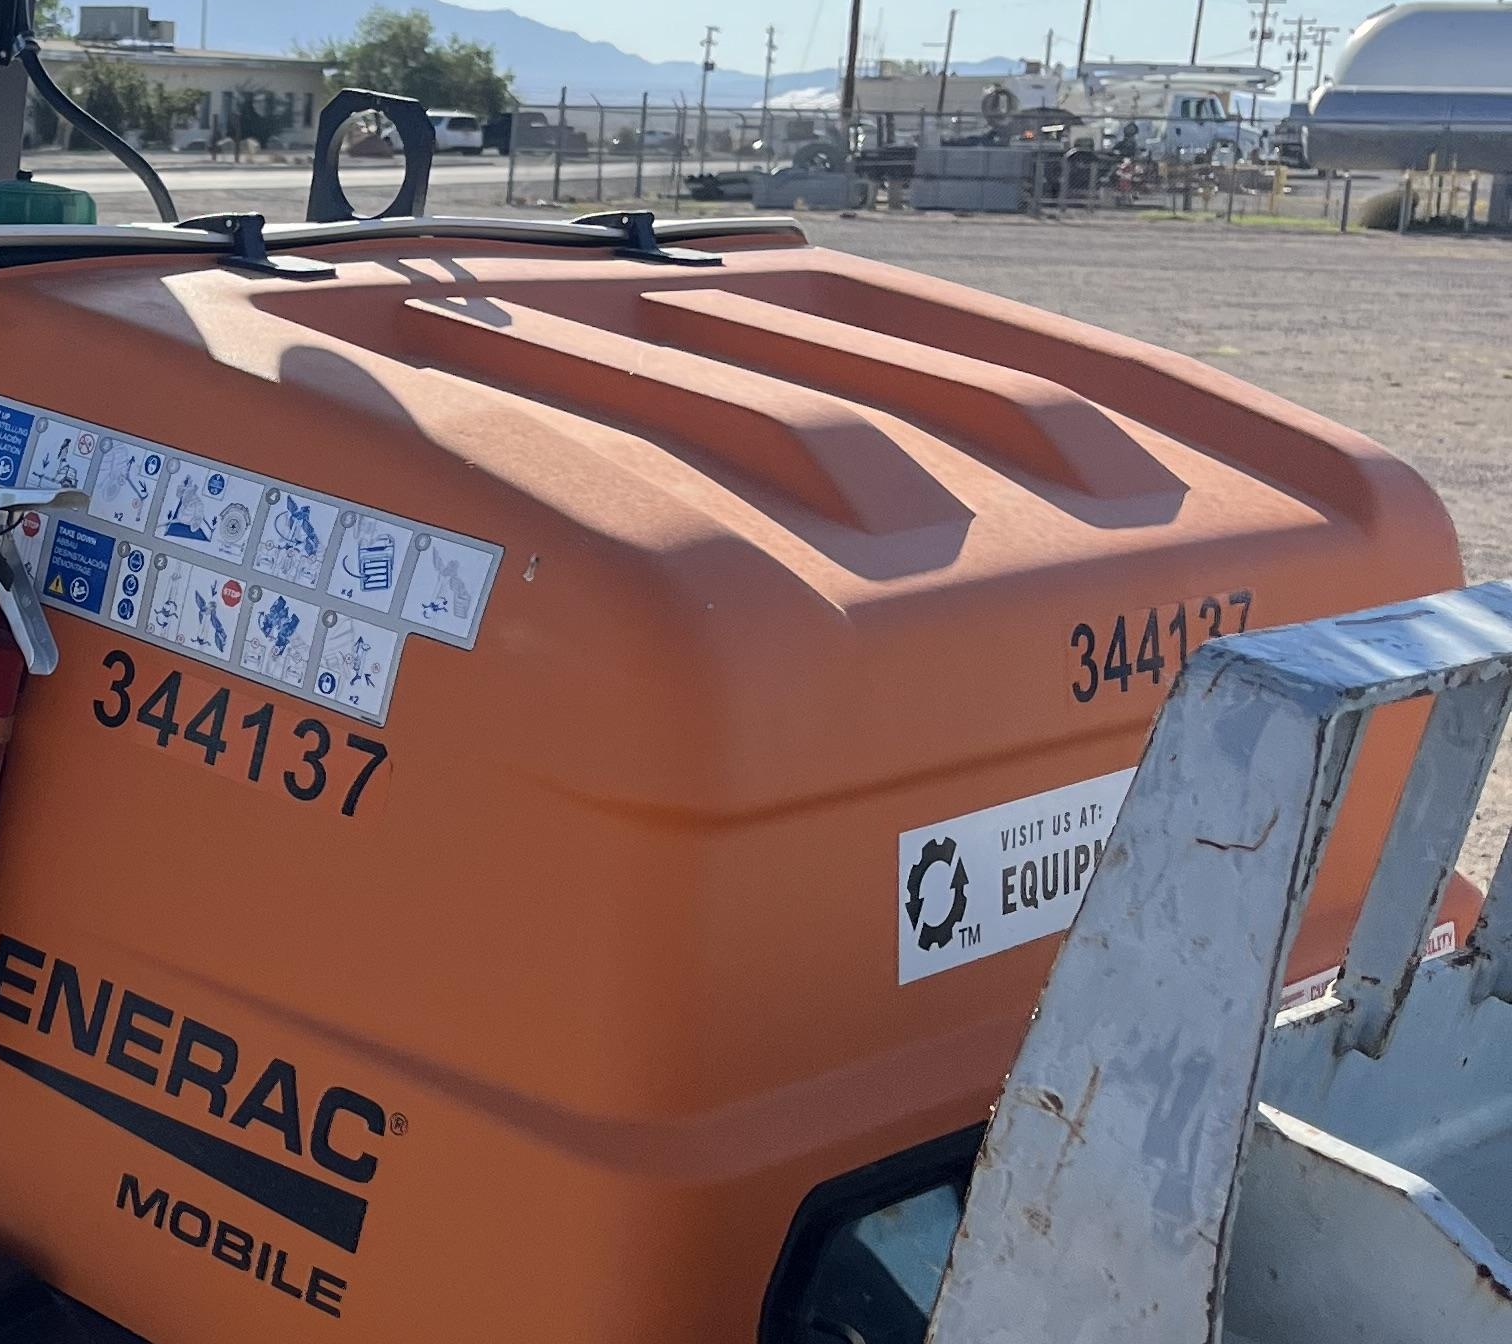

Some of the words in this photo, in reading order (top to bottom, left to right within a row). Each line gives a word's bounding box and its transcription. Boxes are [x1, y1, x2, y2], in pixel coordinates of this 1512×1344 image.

[1071, 589, 1253, 703] 344137
[93, 650, 388, 817] 344137
[1001, 819, 1043, 851] VISIT
[1053, 812, 1070, 836] US
[1080, 804, 1102, 828] AT:
[958, 923, 980, 948] TM
[116, 1173, 347, 1319] MOBILE
